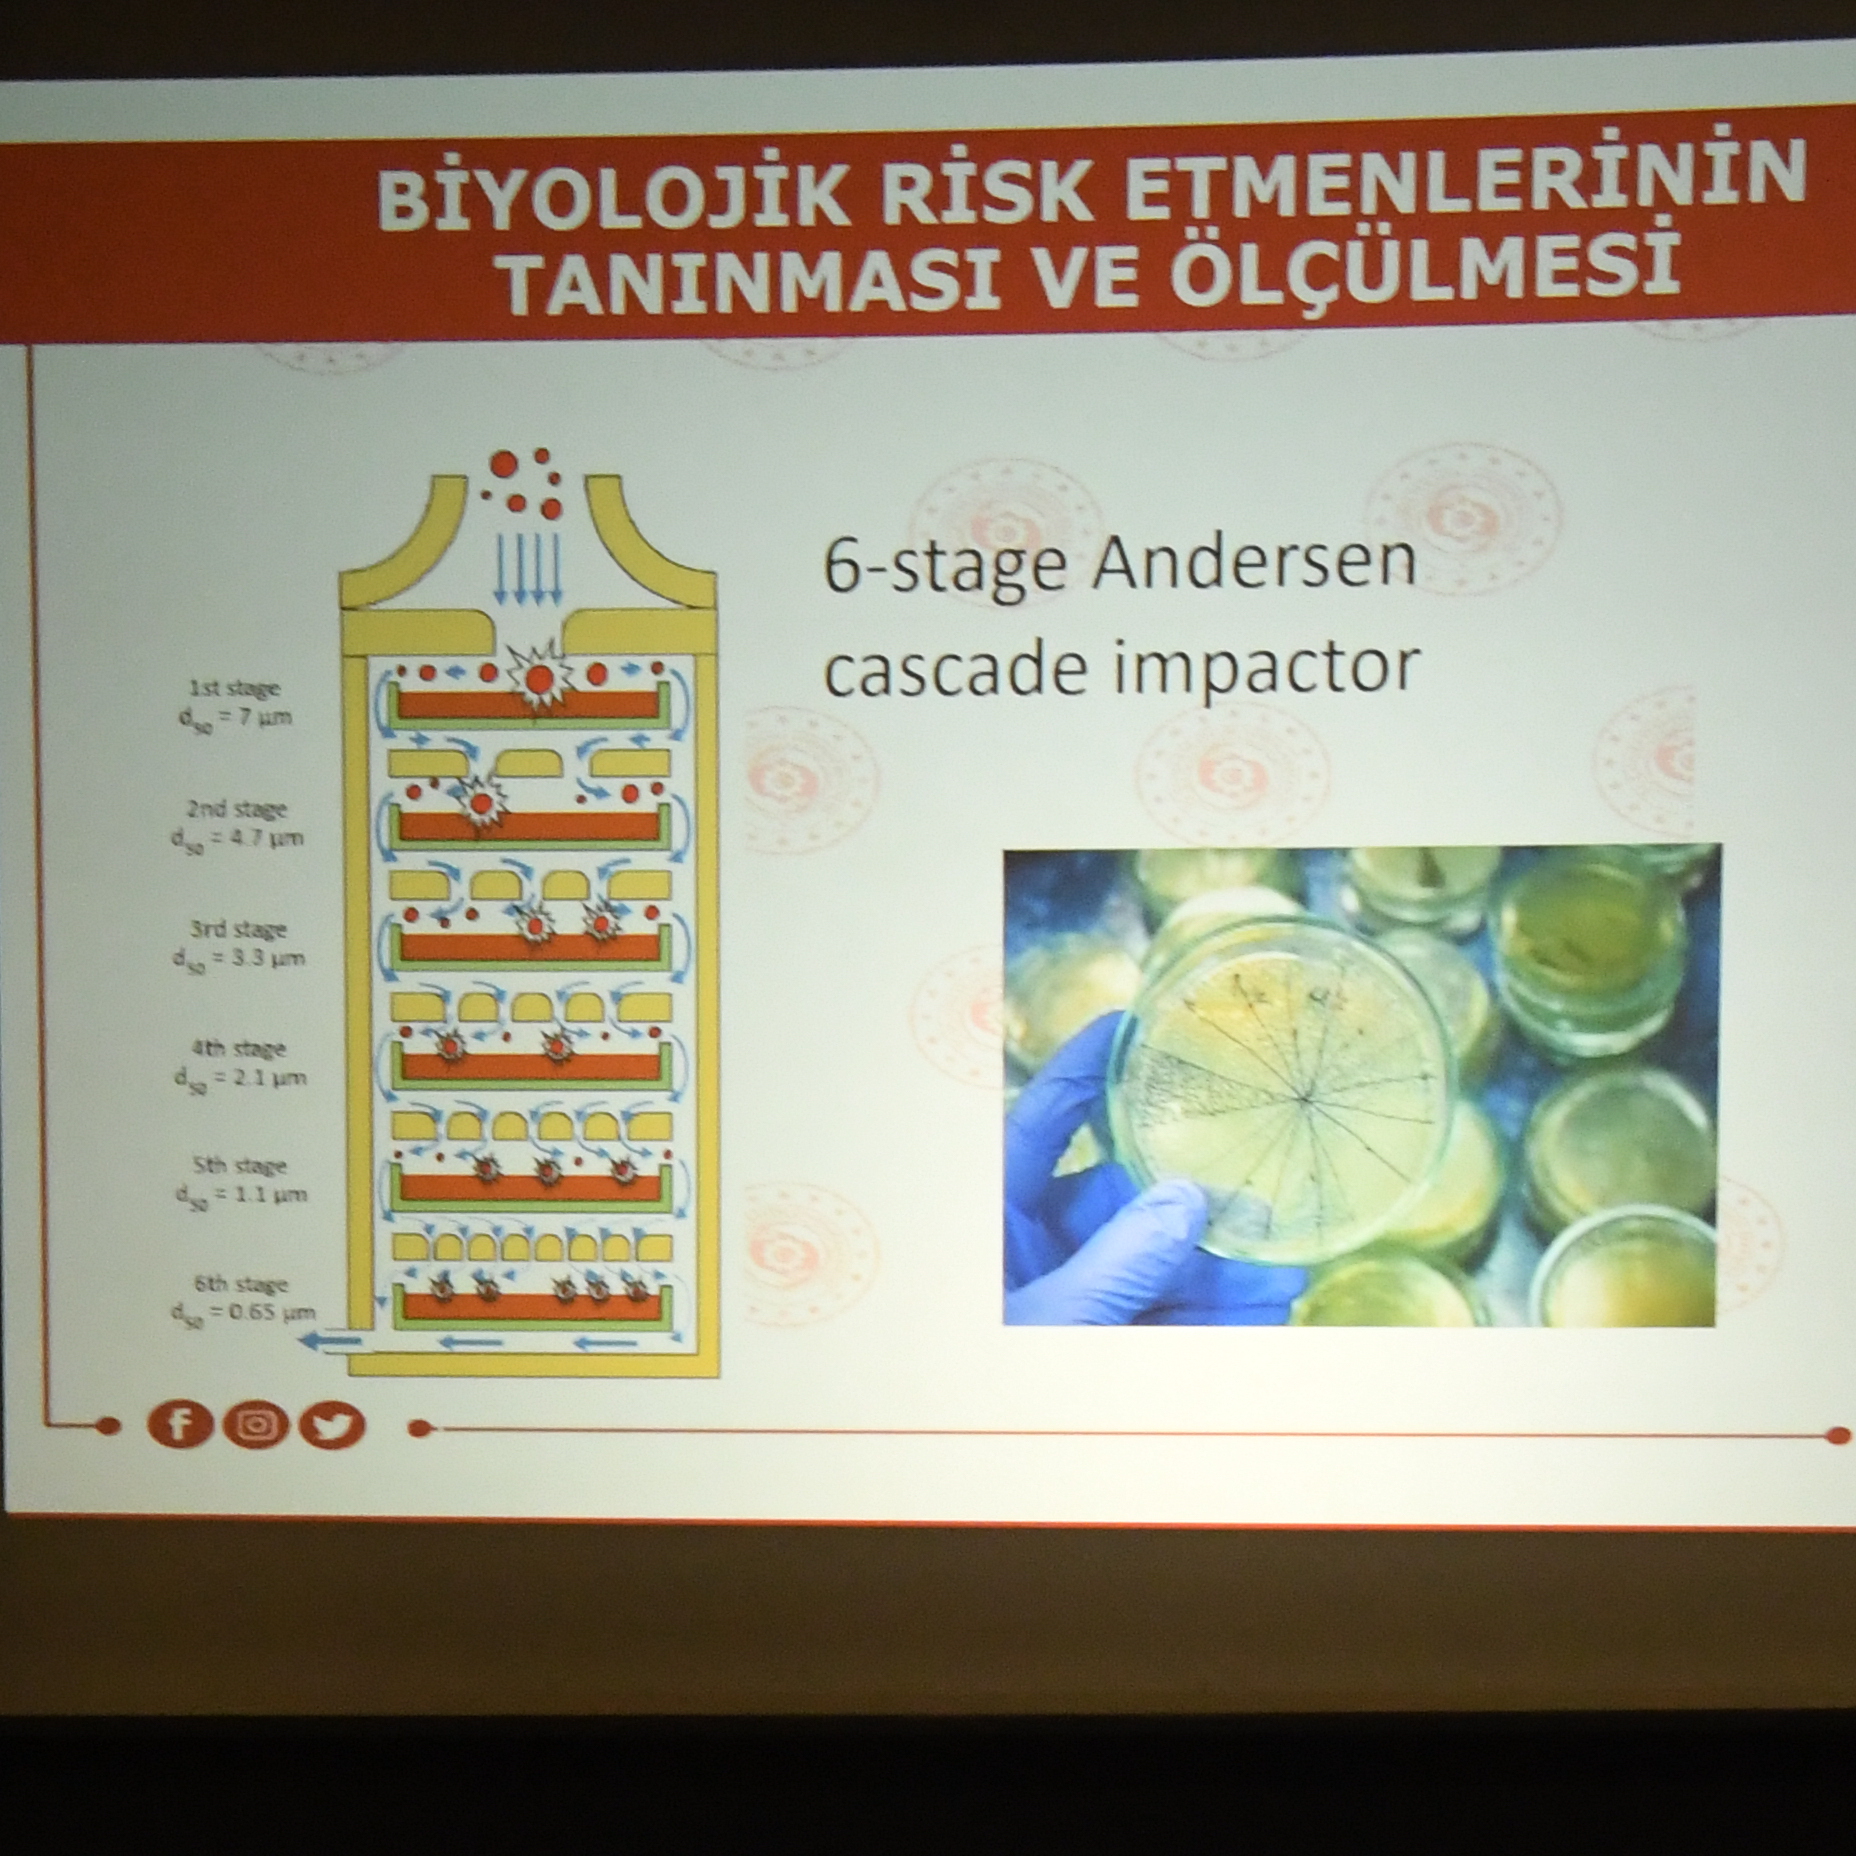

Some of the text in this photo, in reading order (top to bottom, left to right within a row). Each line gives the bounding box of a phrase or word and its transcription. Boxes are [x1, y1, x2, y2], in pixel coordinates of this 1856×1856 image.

[377, 122, 1808, 233] BİYOLOJİK RİSK ETMENLERİNİN
[493, 212, 1682, 321] TANINMASI VE ÖLÇÜLMESİ
[824, 529, 1418, 607] 6-stage Andersen
[824, 636, 1423, 709] cascade impactor
[190, 679, 282, 701] 1st stage
[186, 799, 288, 822] 2nd stage
[191, 919, 288, 942] 3rd stage
[192, 1039, 287, 1061] 4th stage
[193, 1155, 288, 1178] 5th stage
[194, 1275, 289, 1297] 6th stage
